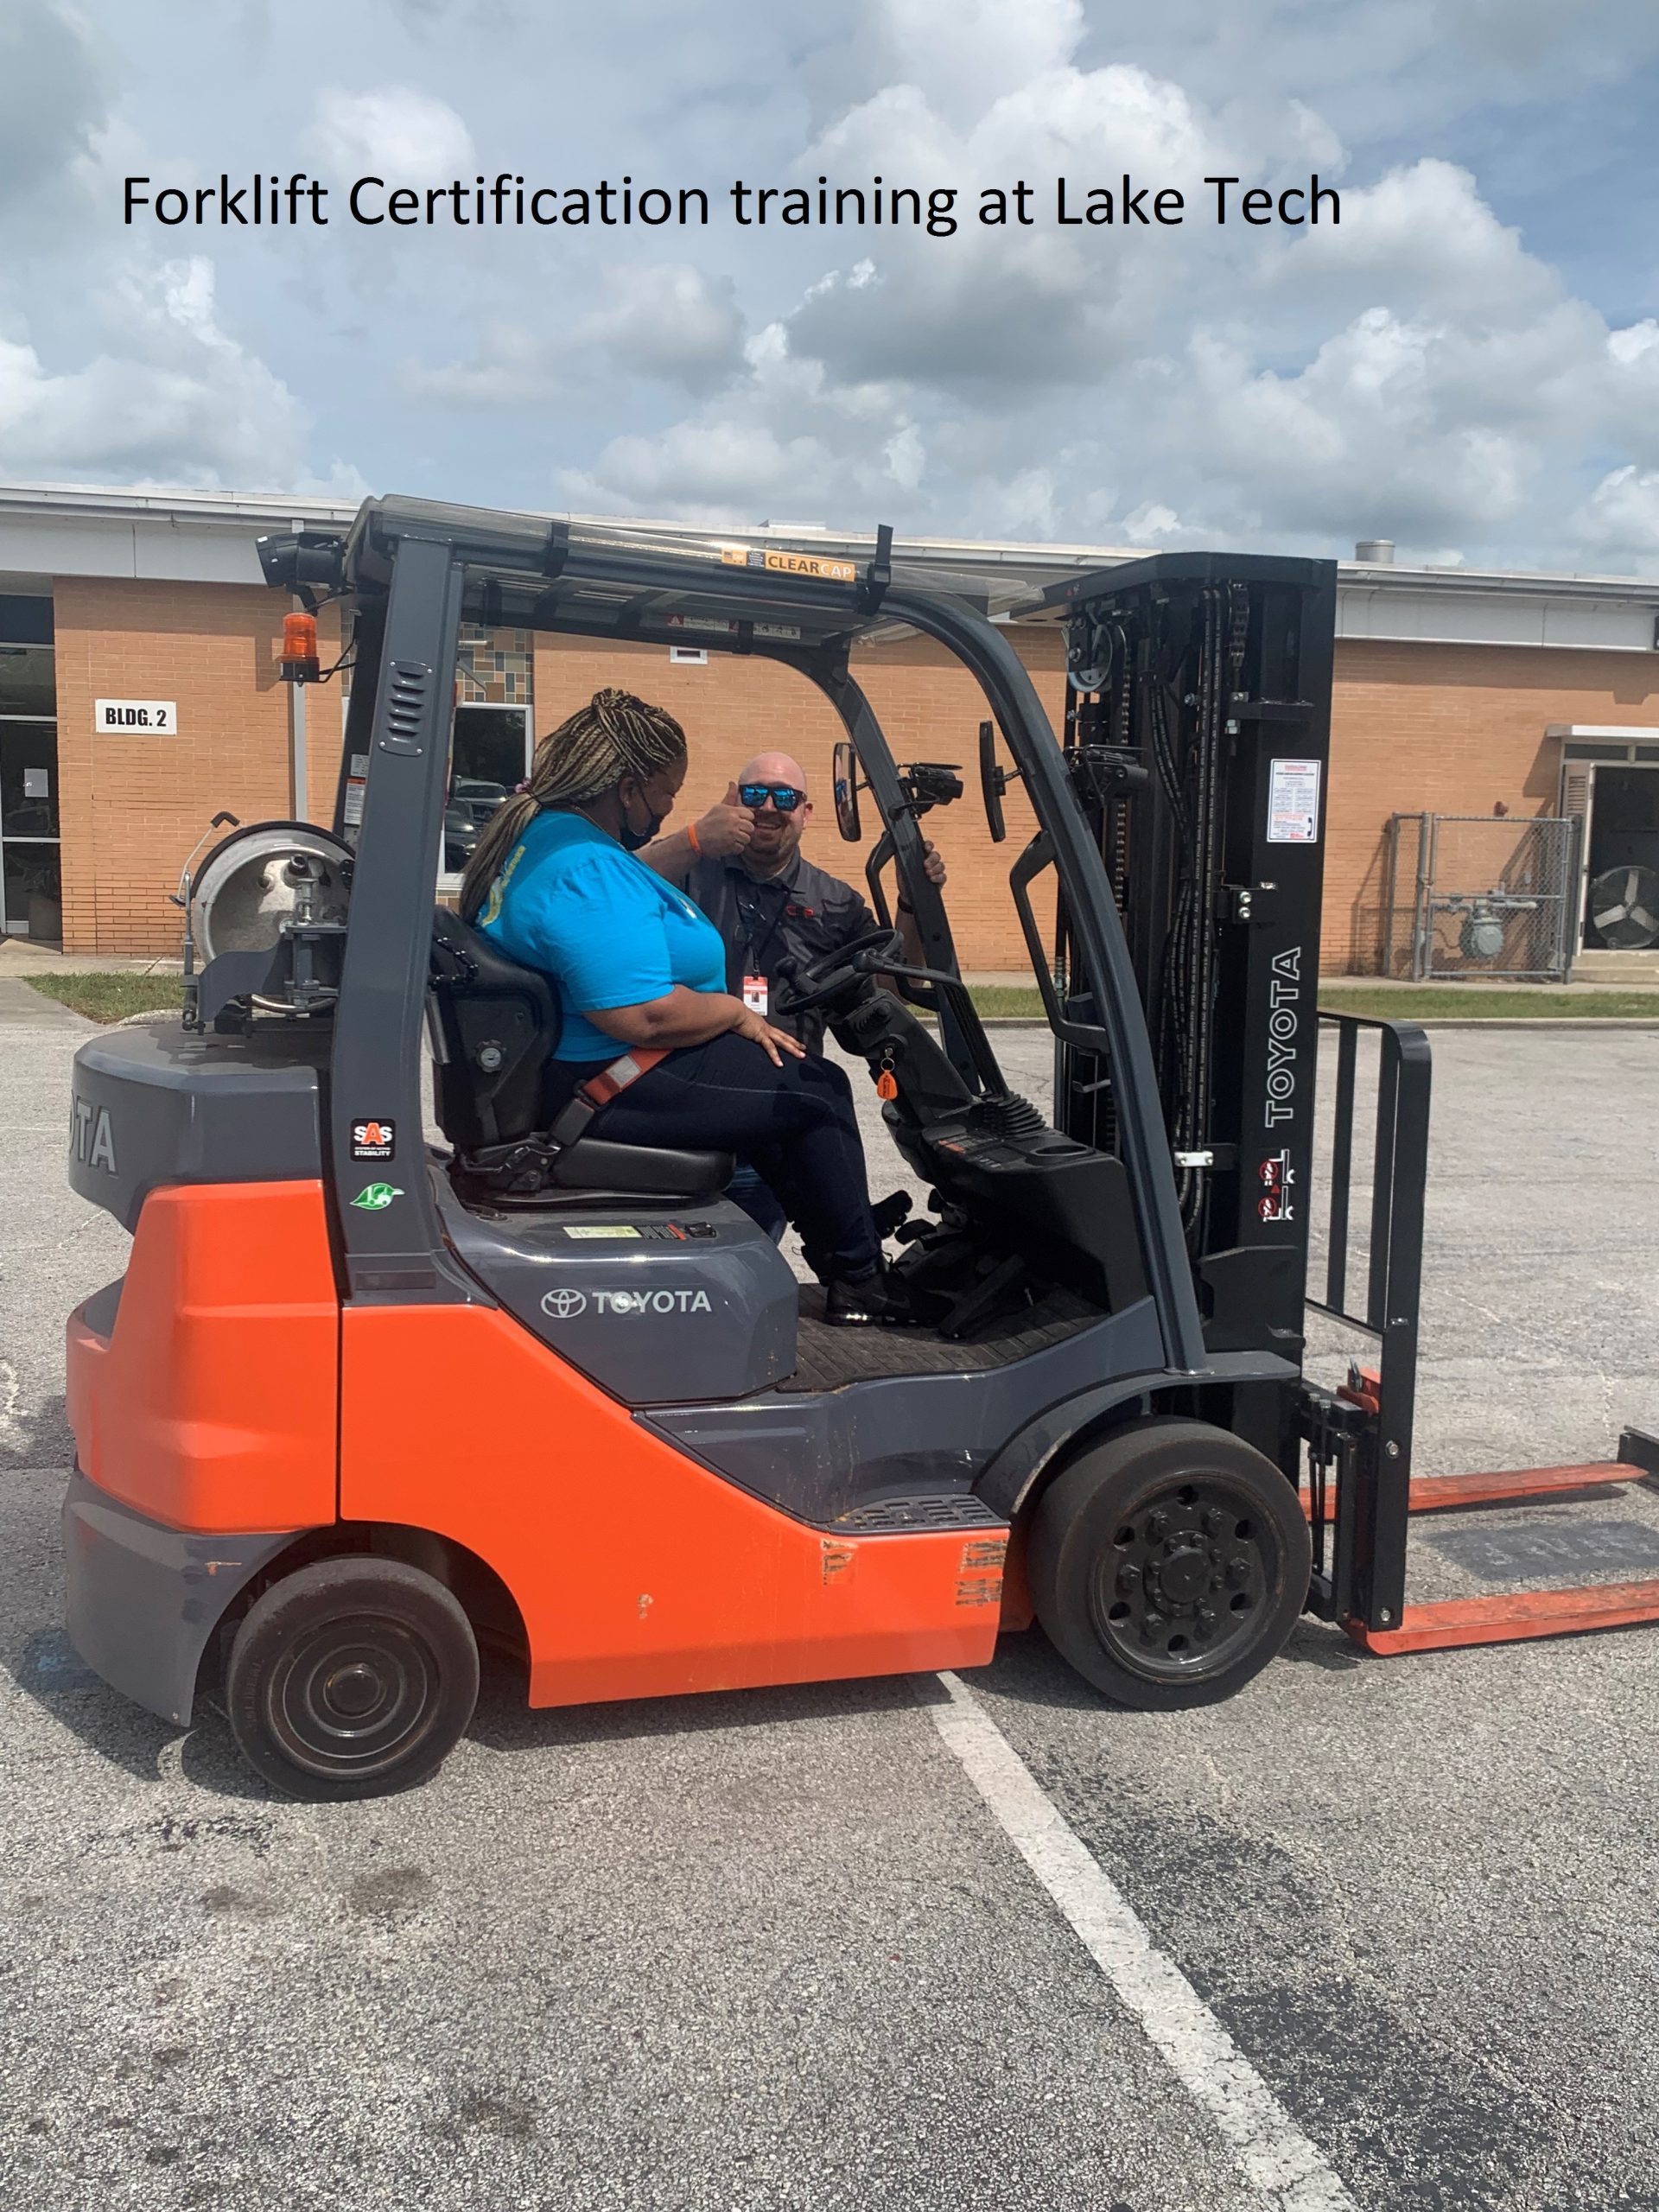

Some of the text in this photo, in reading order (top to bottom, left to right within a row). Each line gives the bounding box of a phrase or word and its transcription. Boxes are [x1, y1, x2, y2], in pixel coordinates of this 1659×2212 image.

[768, 556, 851, 578] CLEARCAP
[105, 708, 167, 727] BLDG. 2
[1265, 946, 1301, 1128] TOYOTA
[69, 1090, 118, 1178] TA
[353, 1122, 393, 1145] SAS
[592, 1290, 712, 1314] TOYOTA
